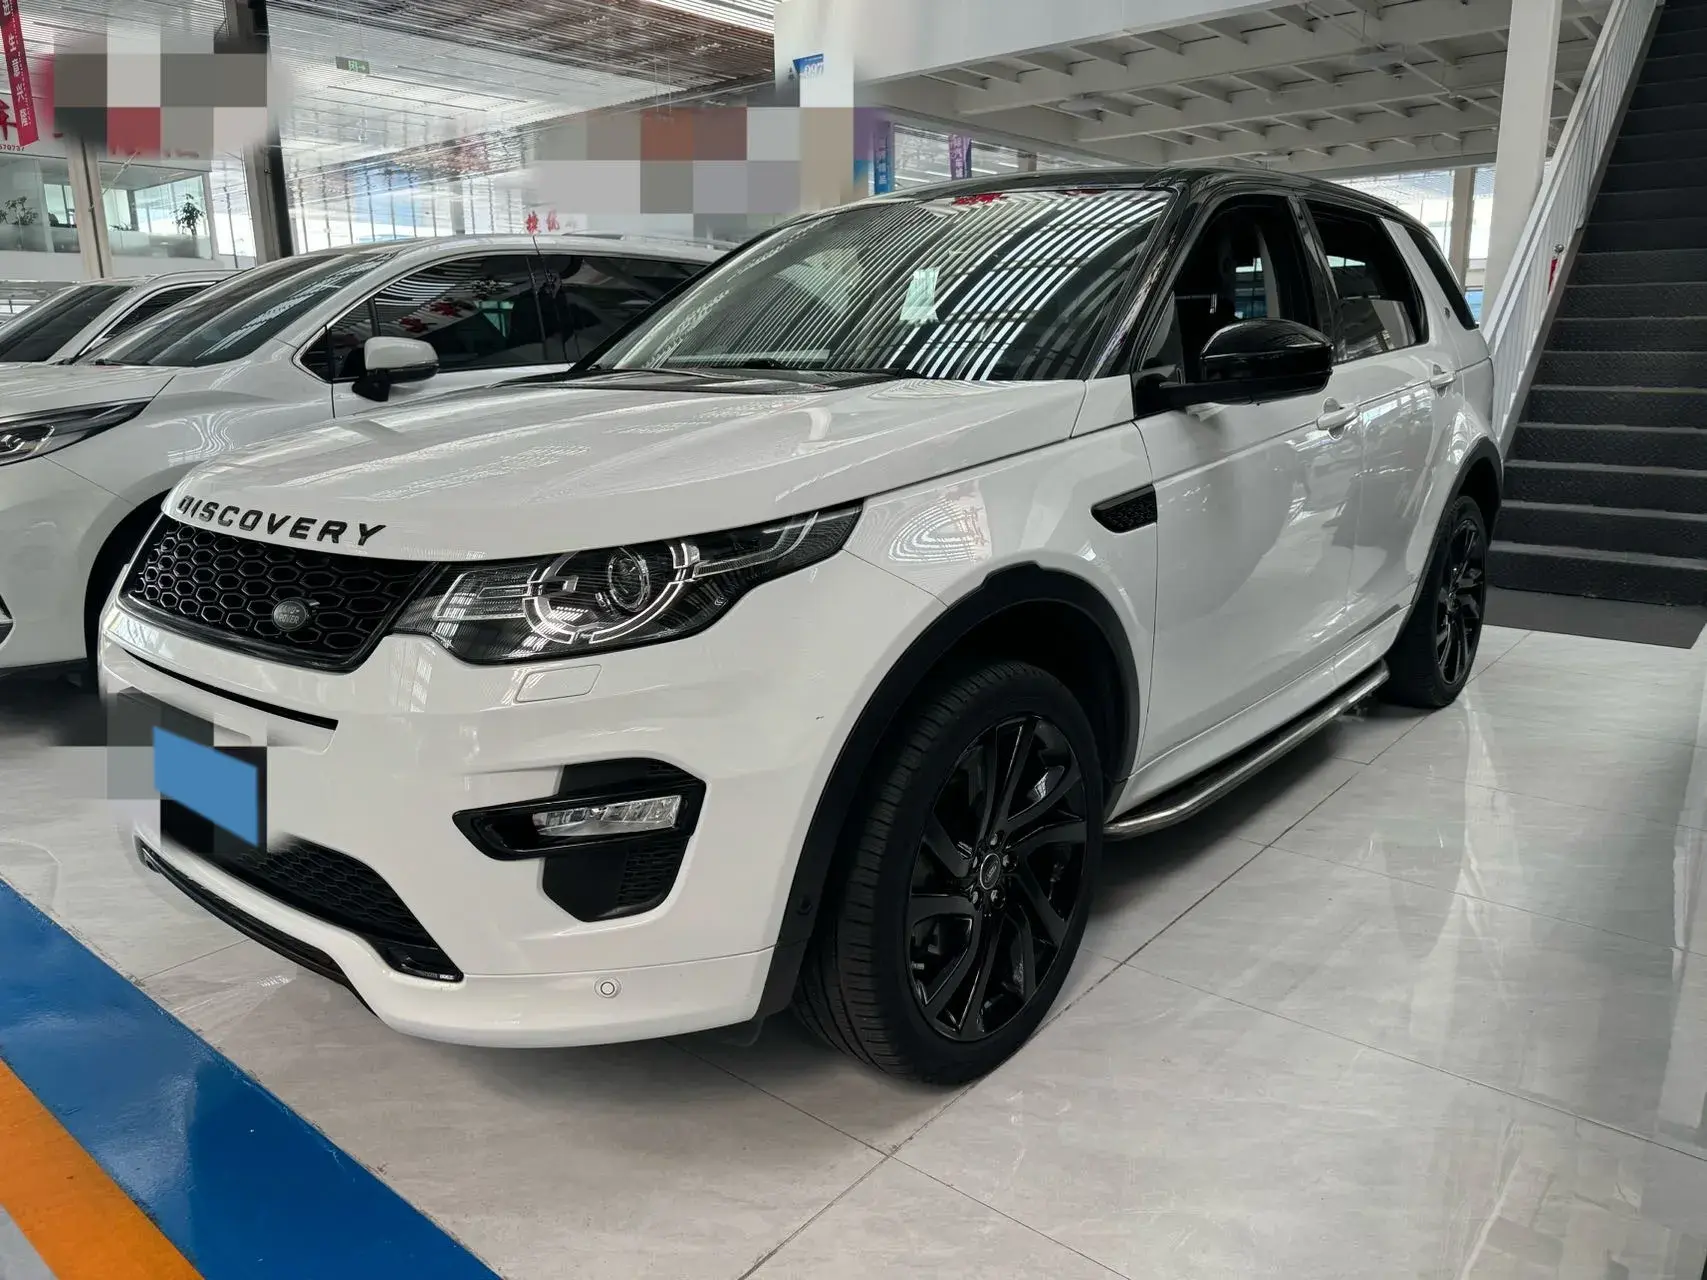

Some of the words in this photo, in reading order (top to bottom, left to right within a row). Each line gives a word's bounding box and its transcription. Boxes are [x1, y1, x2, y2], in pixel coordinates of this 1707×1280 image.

[8, 33, 28, 127] 生意兴隆
[177, 494, 387, 546] DISCOVERY
